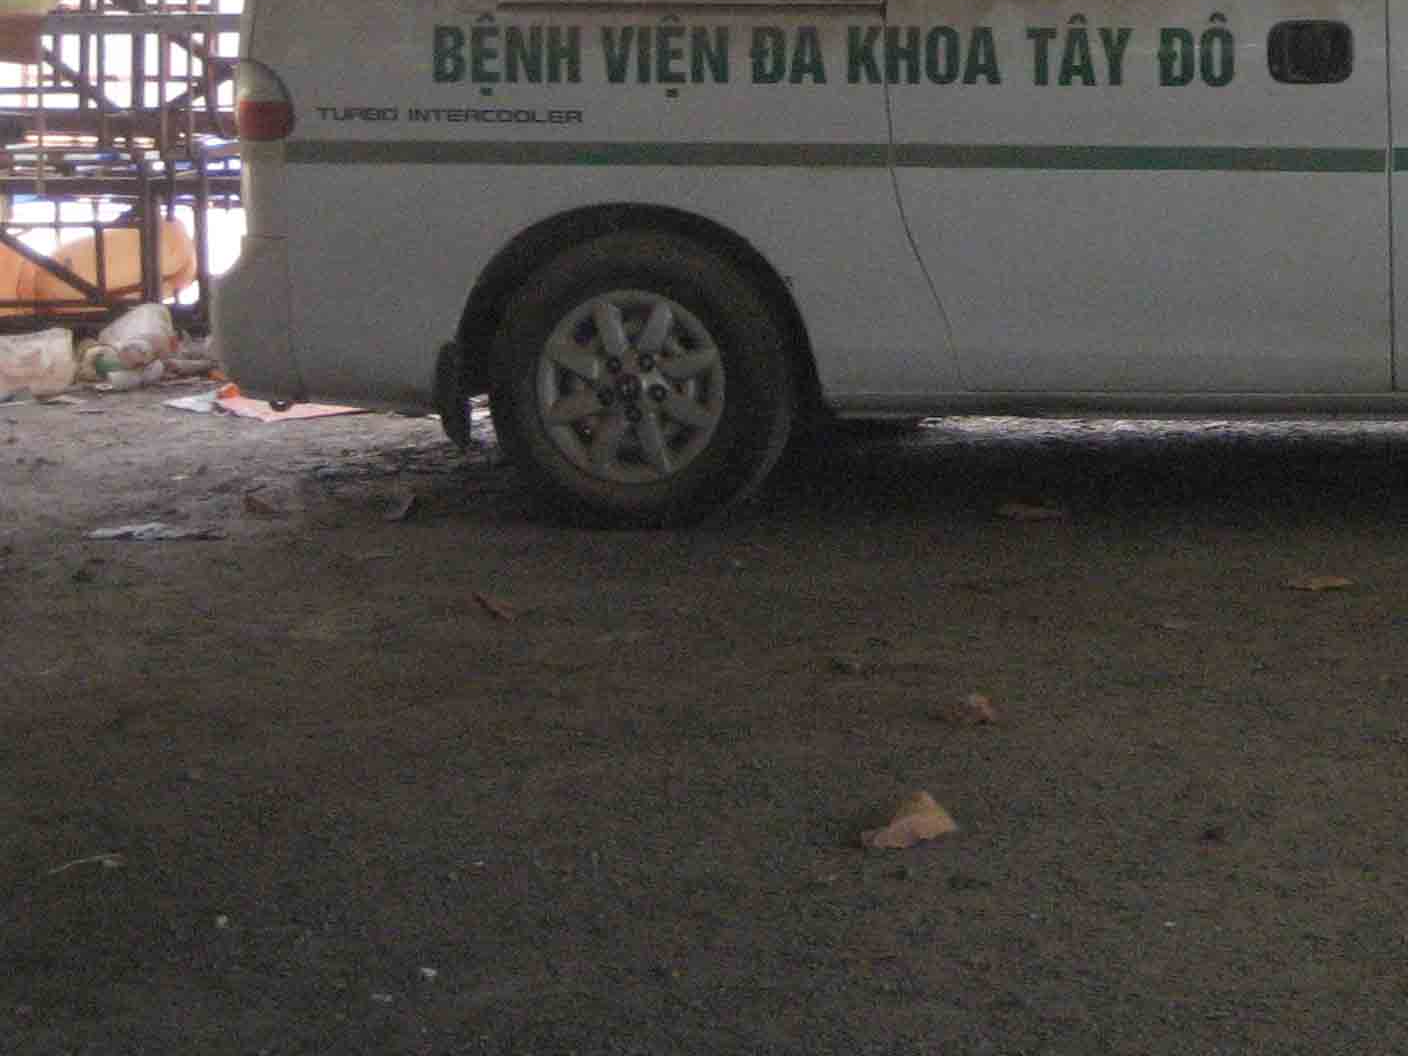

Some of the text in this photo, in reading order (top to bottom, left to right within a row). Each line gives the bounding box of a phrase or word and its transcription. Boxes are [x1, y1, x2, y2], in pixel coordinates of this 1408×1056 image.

[432, 11, 1237, 98] BỆNH VIỆN ĐA KHOA TÂY ĐÔ
[316, 106, 585, 124] TURBO INTERCOOLER
